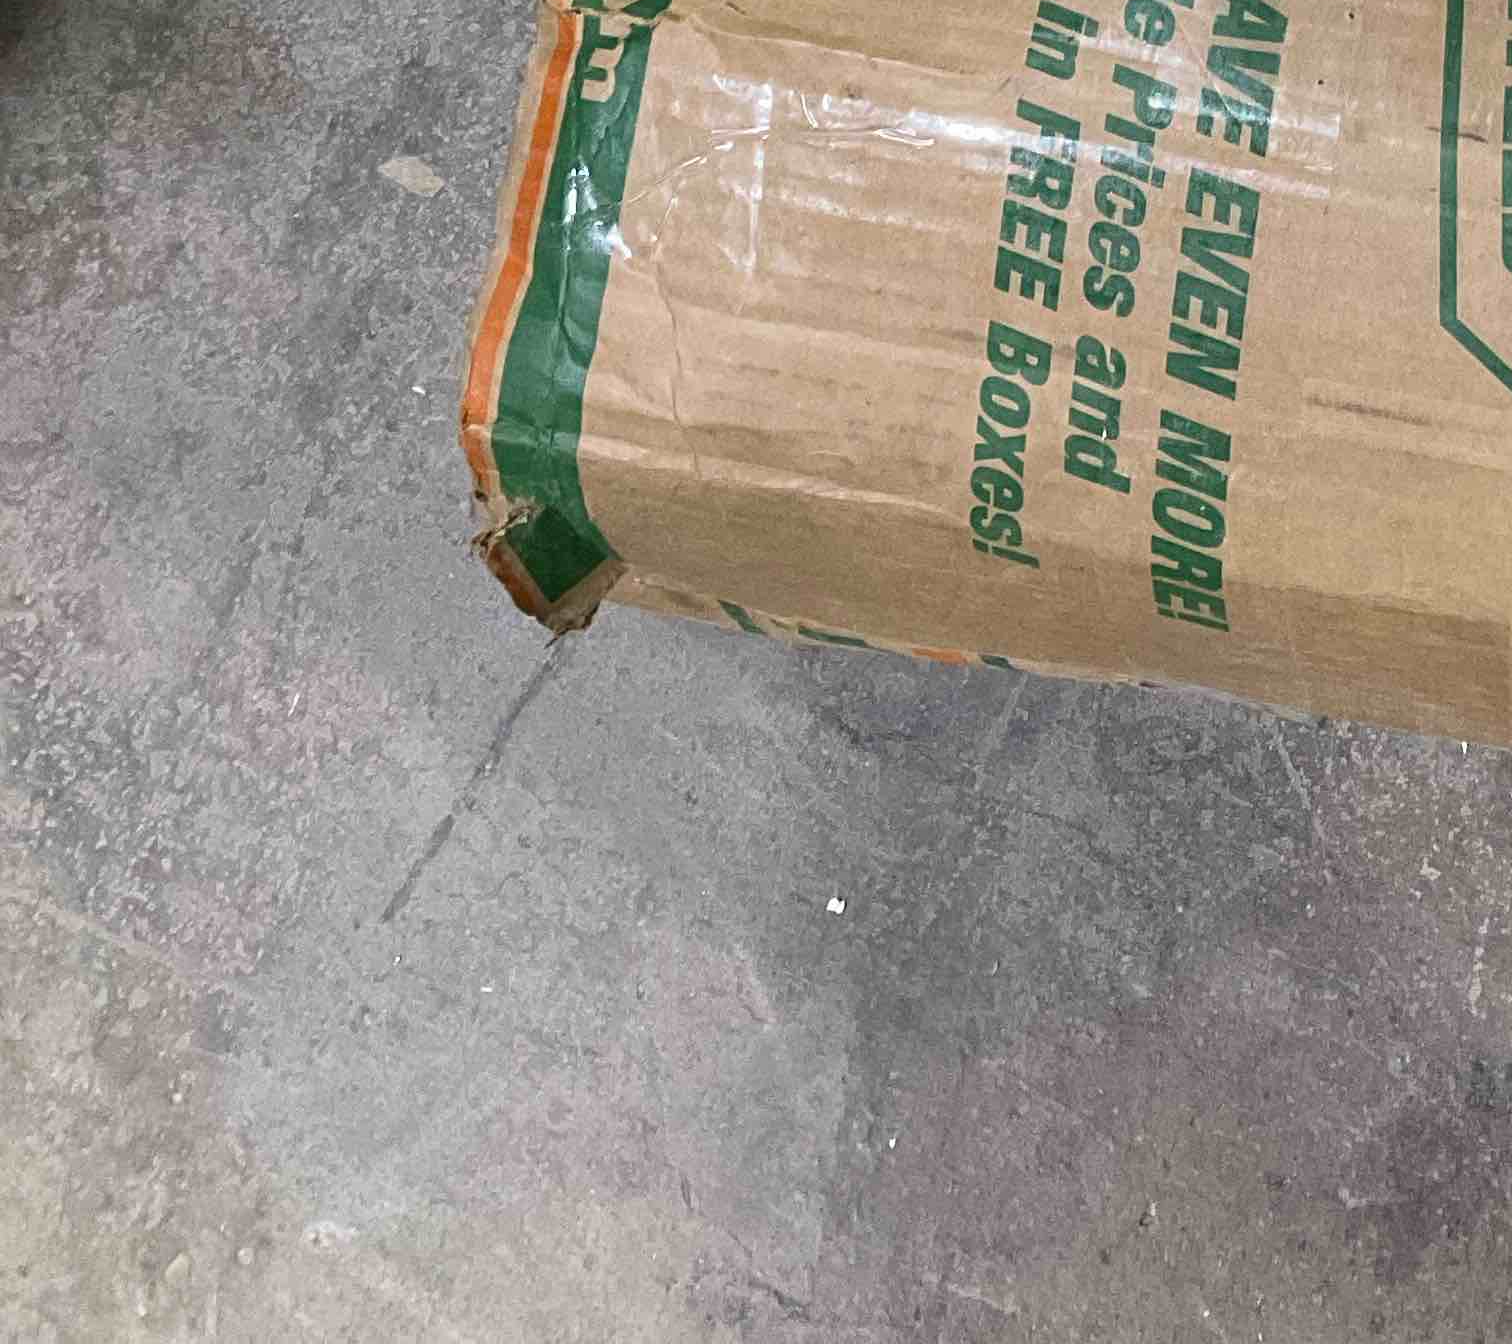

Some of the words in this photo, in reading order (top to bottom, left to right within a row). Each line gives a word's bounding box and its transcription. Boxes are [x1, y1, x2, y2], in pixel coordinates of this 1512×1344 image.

[1025, 0, 1101, 82] in
[993, 97, 1084, 313] FREE
[1083, 63, 1168, 320] Prices
[1164, 161, 1262, 403] EVEN
[970, 319, 1055, 570] Boxes!
[1063, 332, 1133, 494] and
[1150, 407, 1234, 635] MORE!
